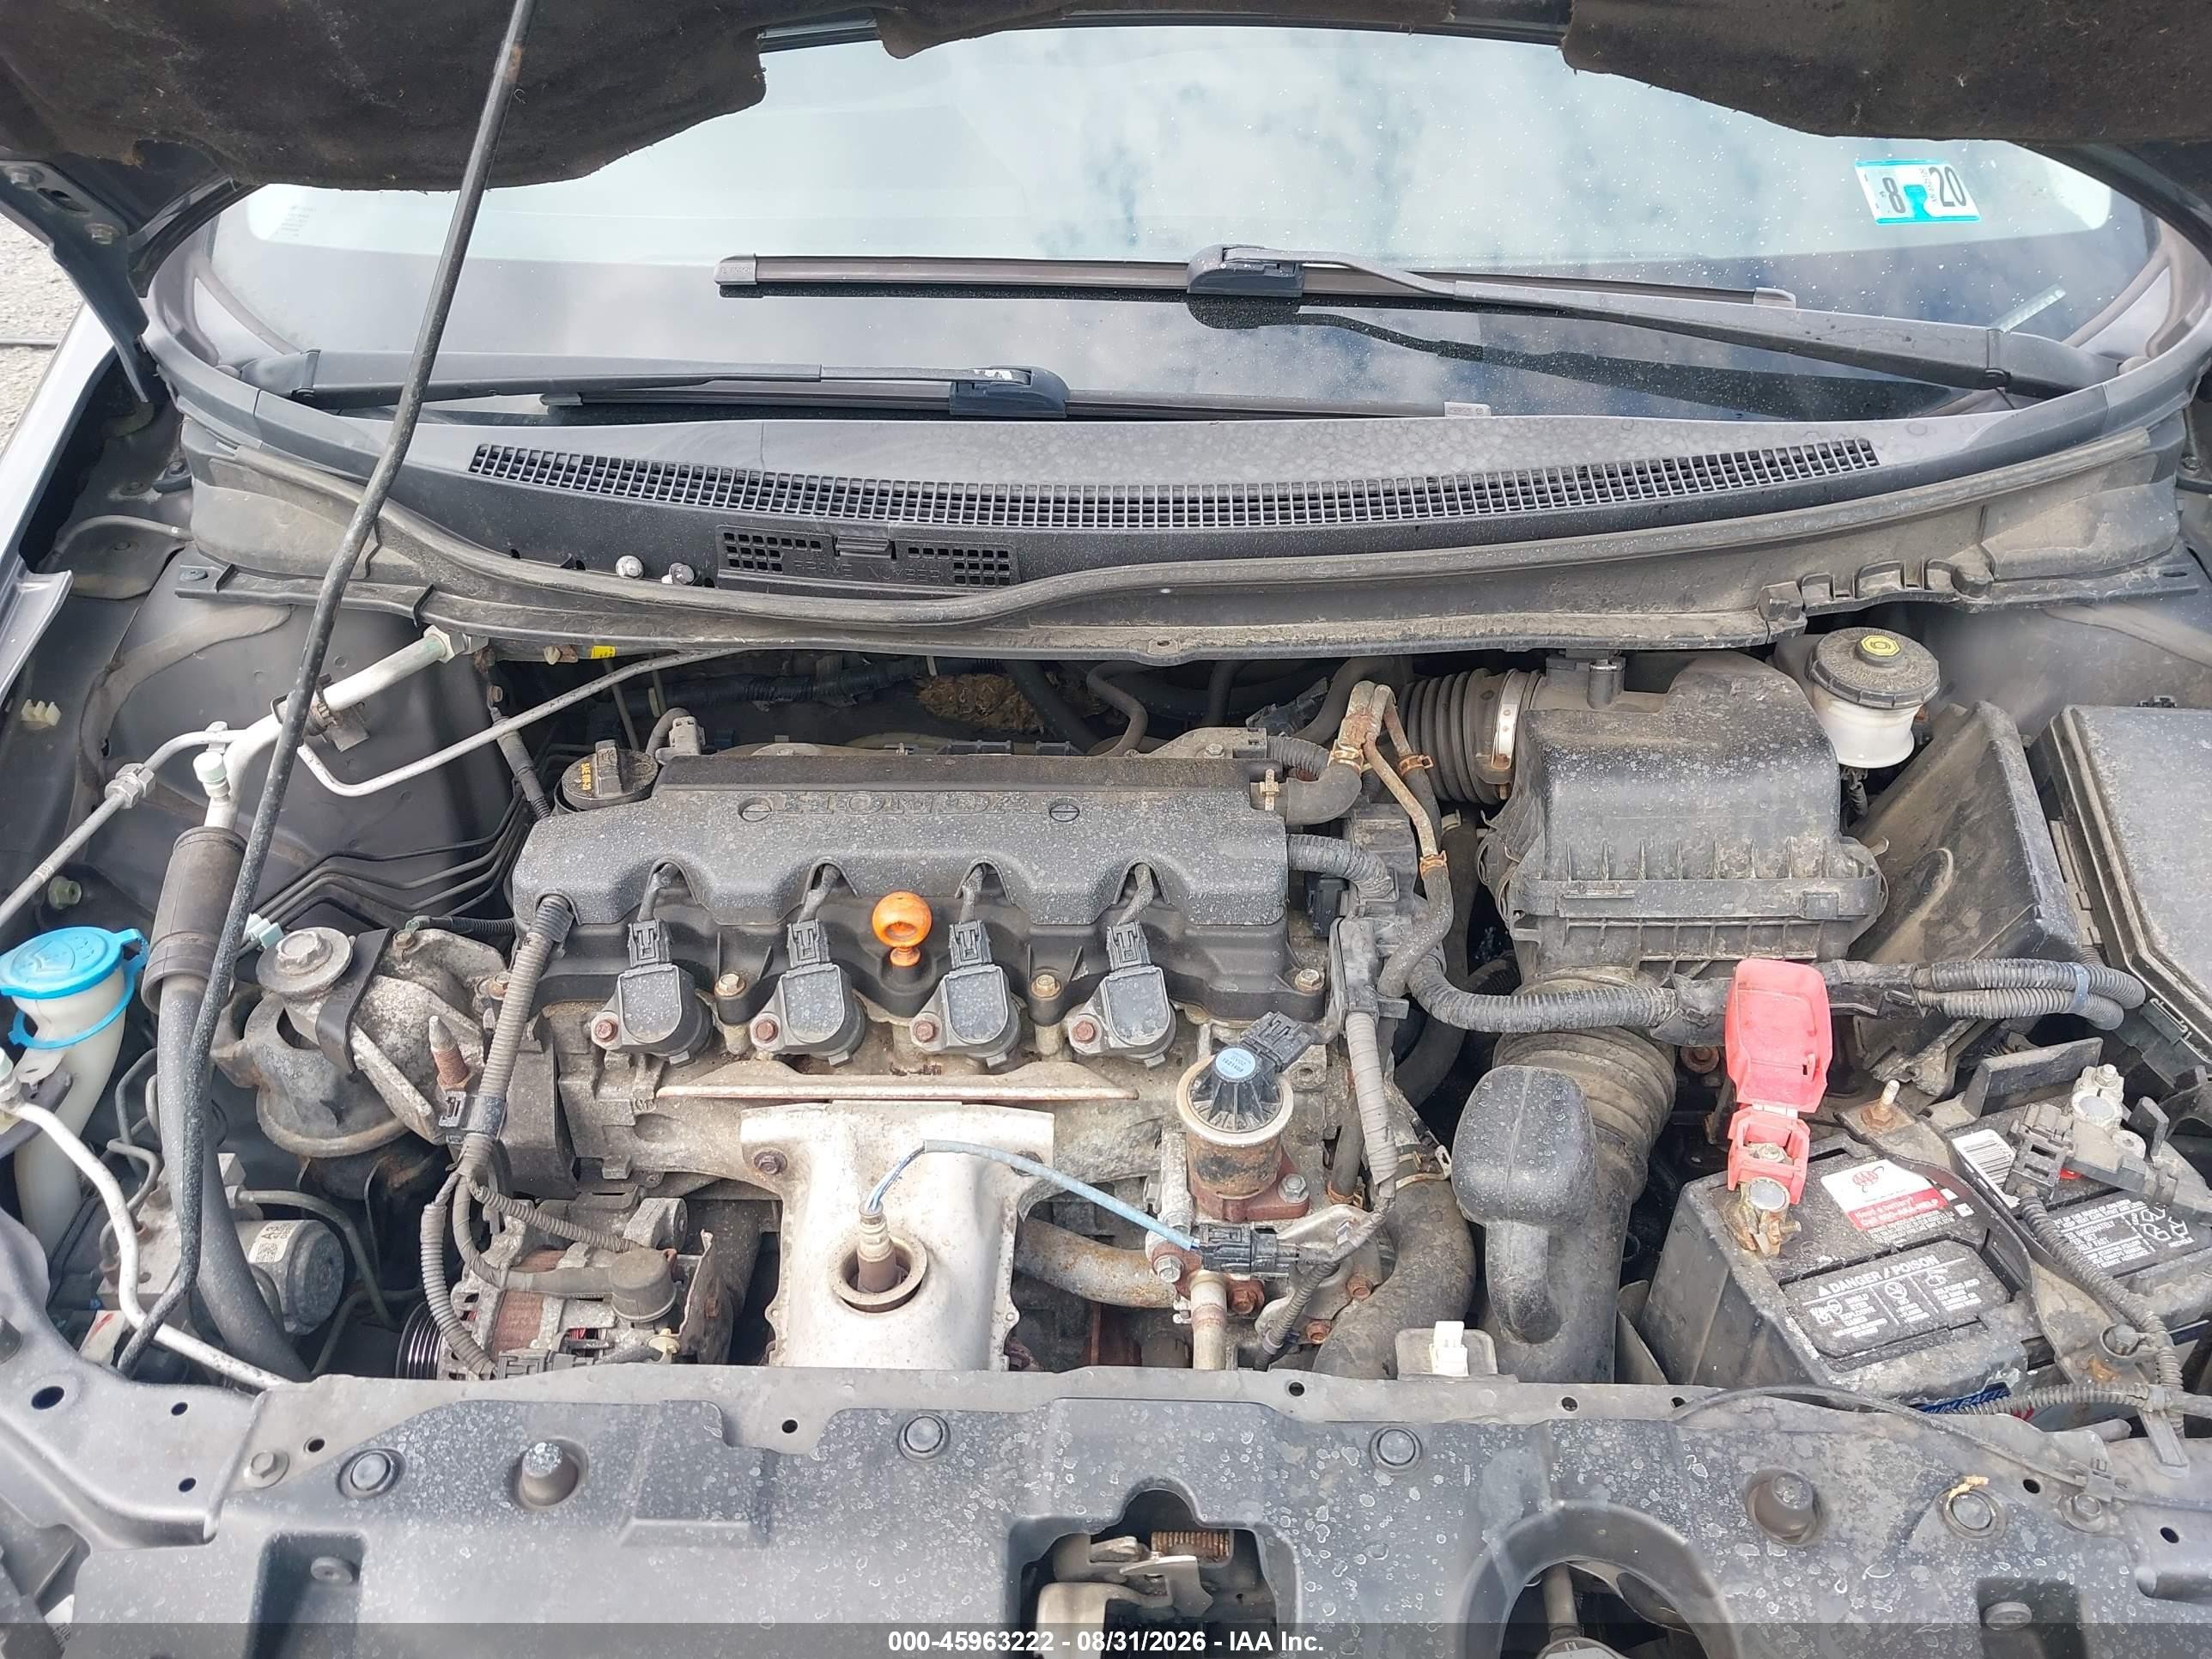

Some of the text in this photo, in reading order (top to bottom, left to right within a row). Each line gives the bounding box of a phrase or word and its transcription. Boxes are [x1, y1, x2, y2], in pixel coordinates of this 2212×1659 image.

[1881, 177, 1906, 214] 8
[1929, 166, 1966, 207] 20
[777, 792, 1030, 815] HONDA
[1829, 1271, 1882, 1294] DANGER
[1890, 1255, 1941, 1276] POISON
